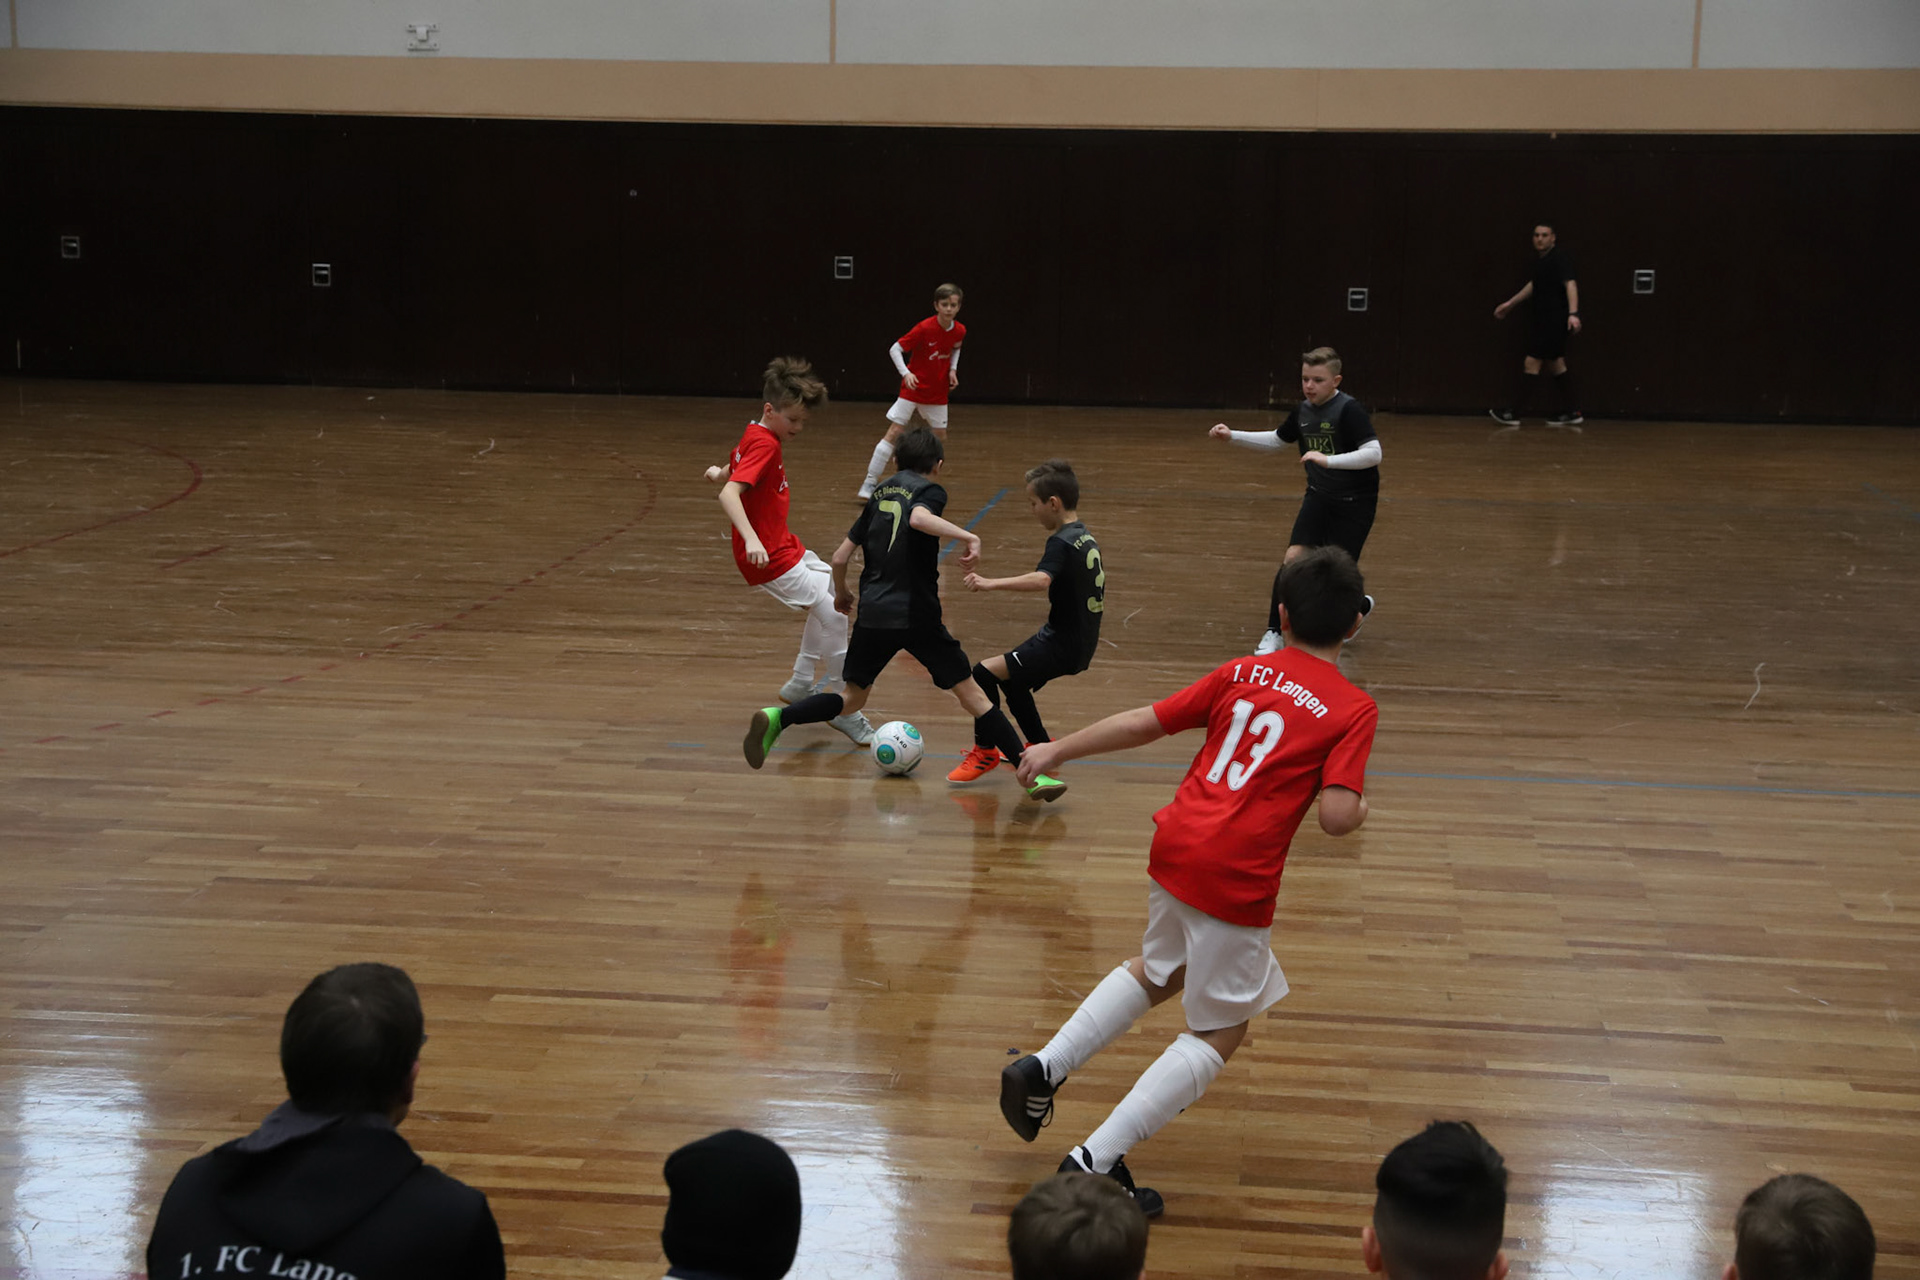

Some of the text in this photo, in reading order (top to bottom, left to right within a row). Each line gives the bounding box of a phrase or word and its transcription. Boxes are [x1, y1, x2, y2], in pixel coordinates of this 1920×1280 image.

[878, 500, 902, 553] 7
[1086, 548, 1105, 614] 3
[1233, 664, 1329, 719] 1. FC Langen
[1206, 698, 1285, 792] 13
[179, 1252, 202, 1280] 1.
[214, 1245, 262, 1273] FC
